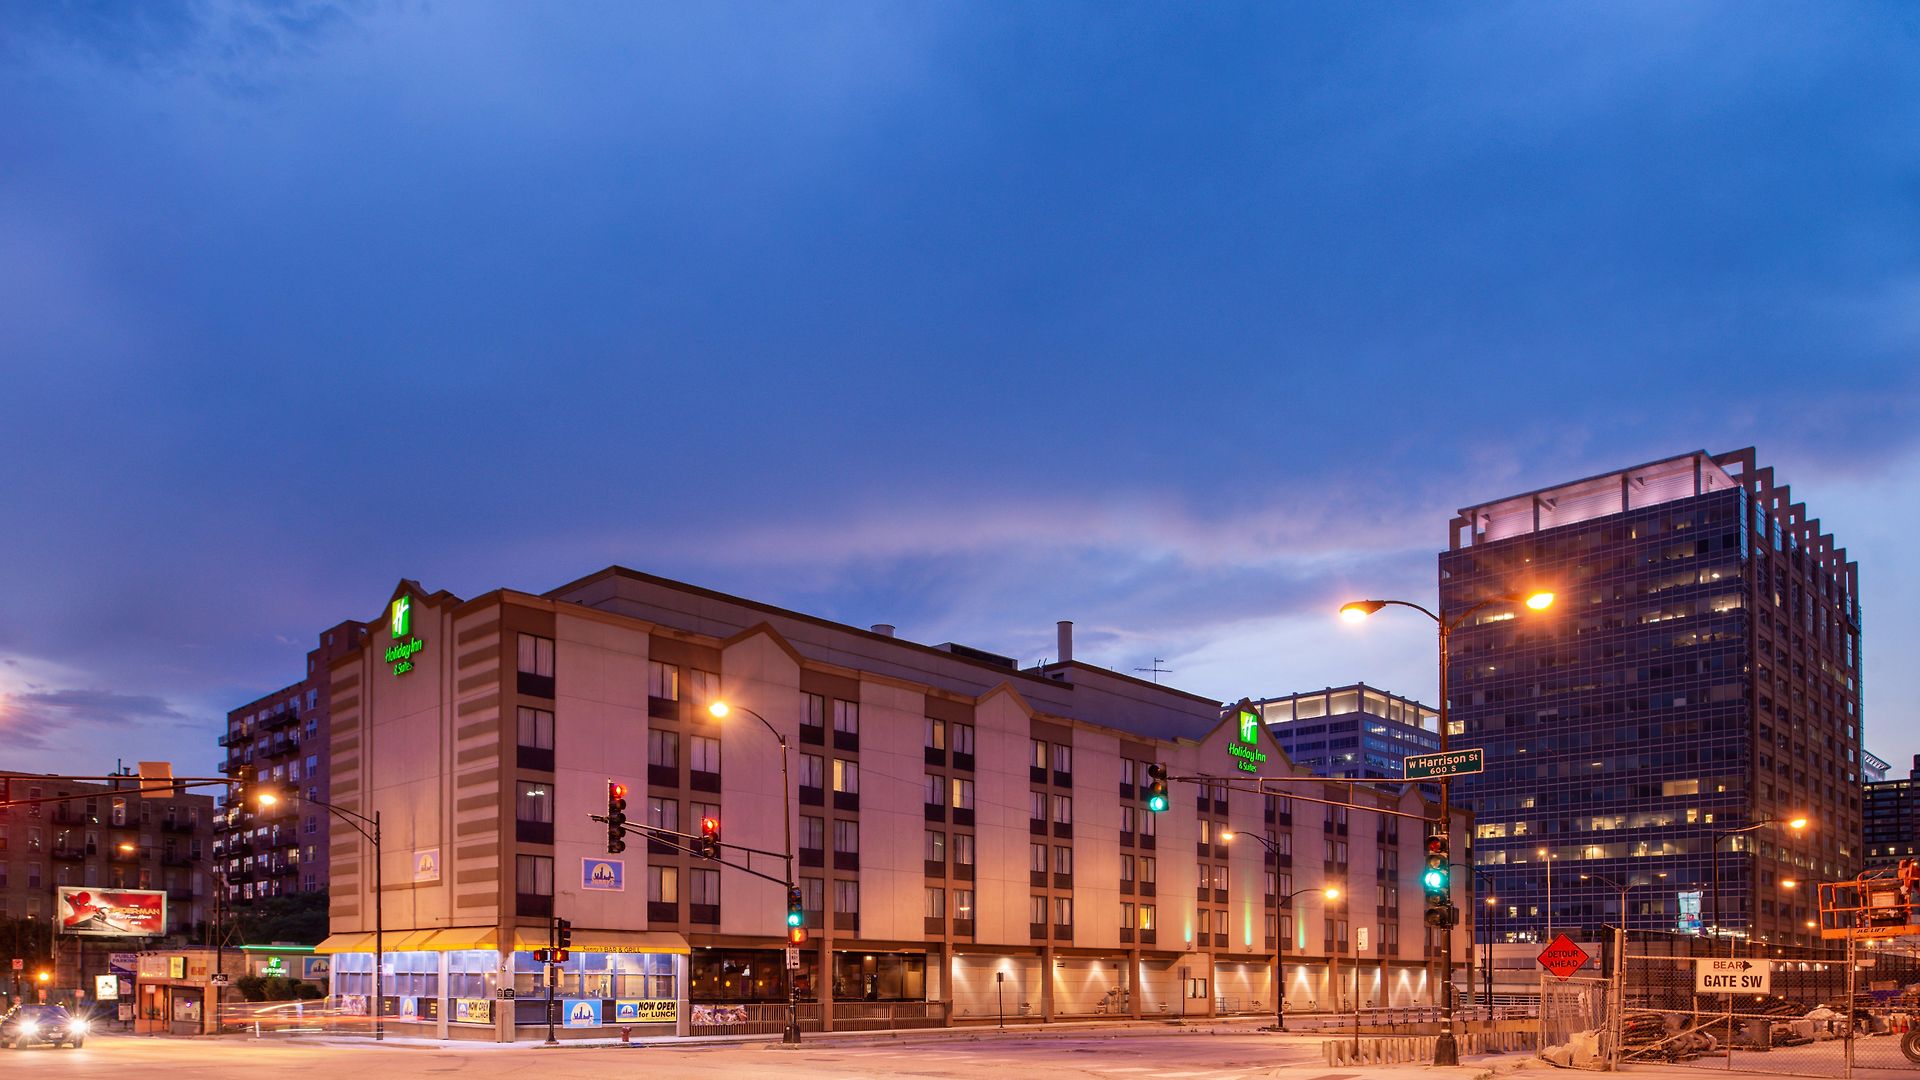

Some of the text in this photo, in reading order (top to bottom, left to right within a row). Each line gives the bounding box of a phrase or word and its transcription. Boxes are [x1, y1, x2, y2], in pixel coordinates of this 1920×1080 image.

[385, 637, 422, 663] Holiday Inn
[1229, 742, 1267, 763] Holiday Inn
[1408, 753, 1478, 769] W Harrison St
[1243, 762, 1257, 773] Suites
[1430, 766, 1447, 775] 600
[1547, 950, 1579, 959] DETOUR
[1549, 960, 1578, 968] AHEAD
[1713, 961, 1742, 969] BEAR
[1704, 974, 1763, 988] GATE SW
[638, 1002, 676, 1011] NOW OPEN
[651, 1010, 676, 1018] LUNCH
